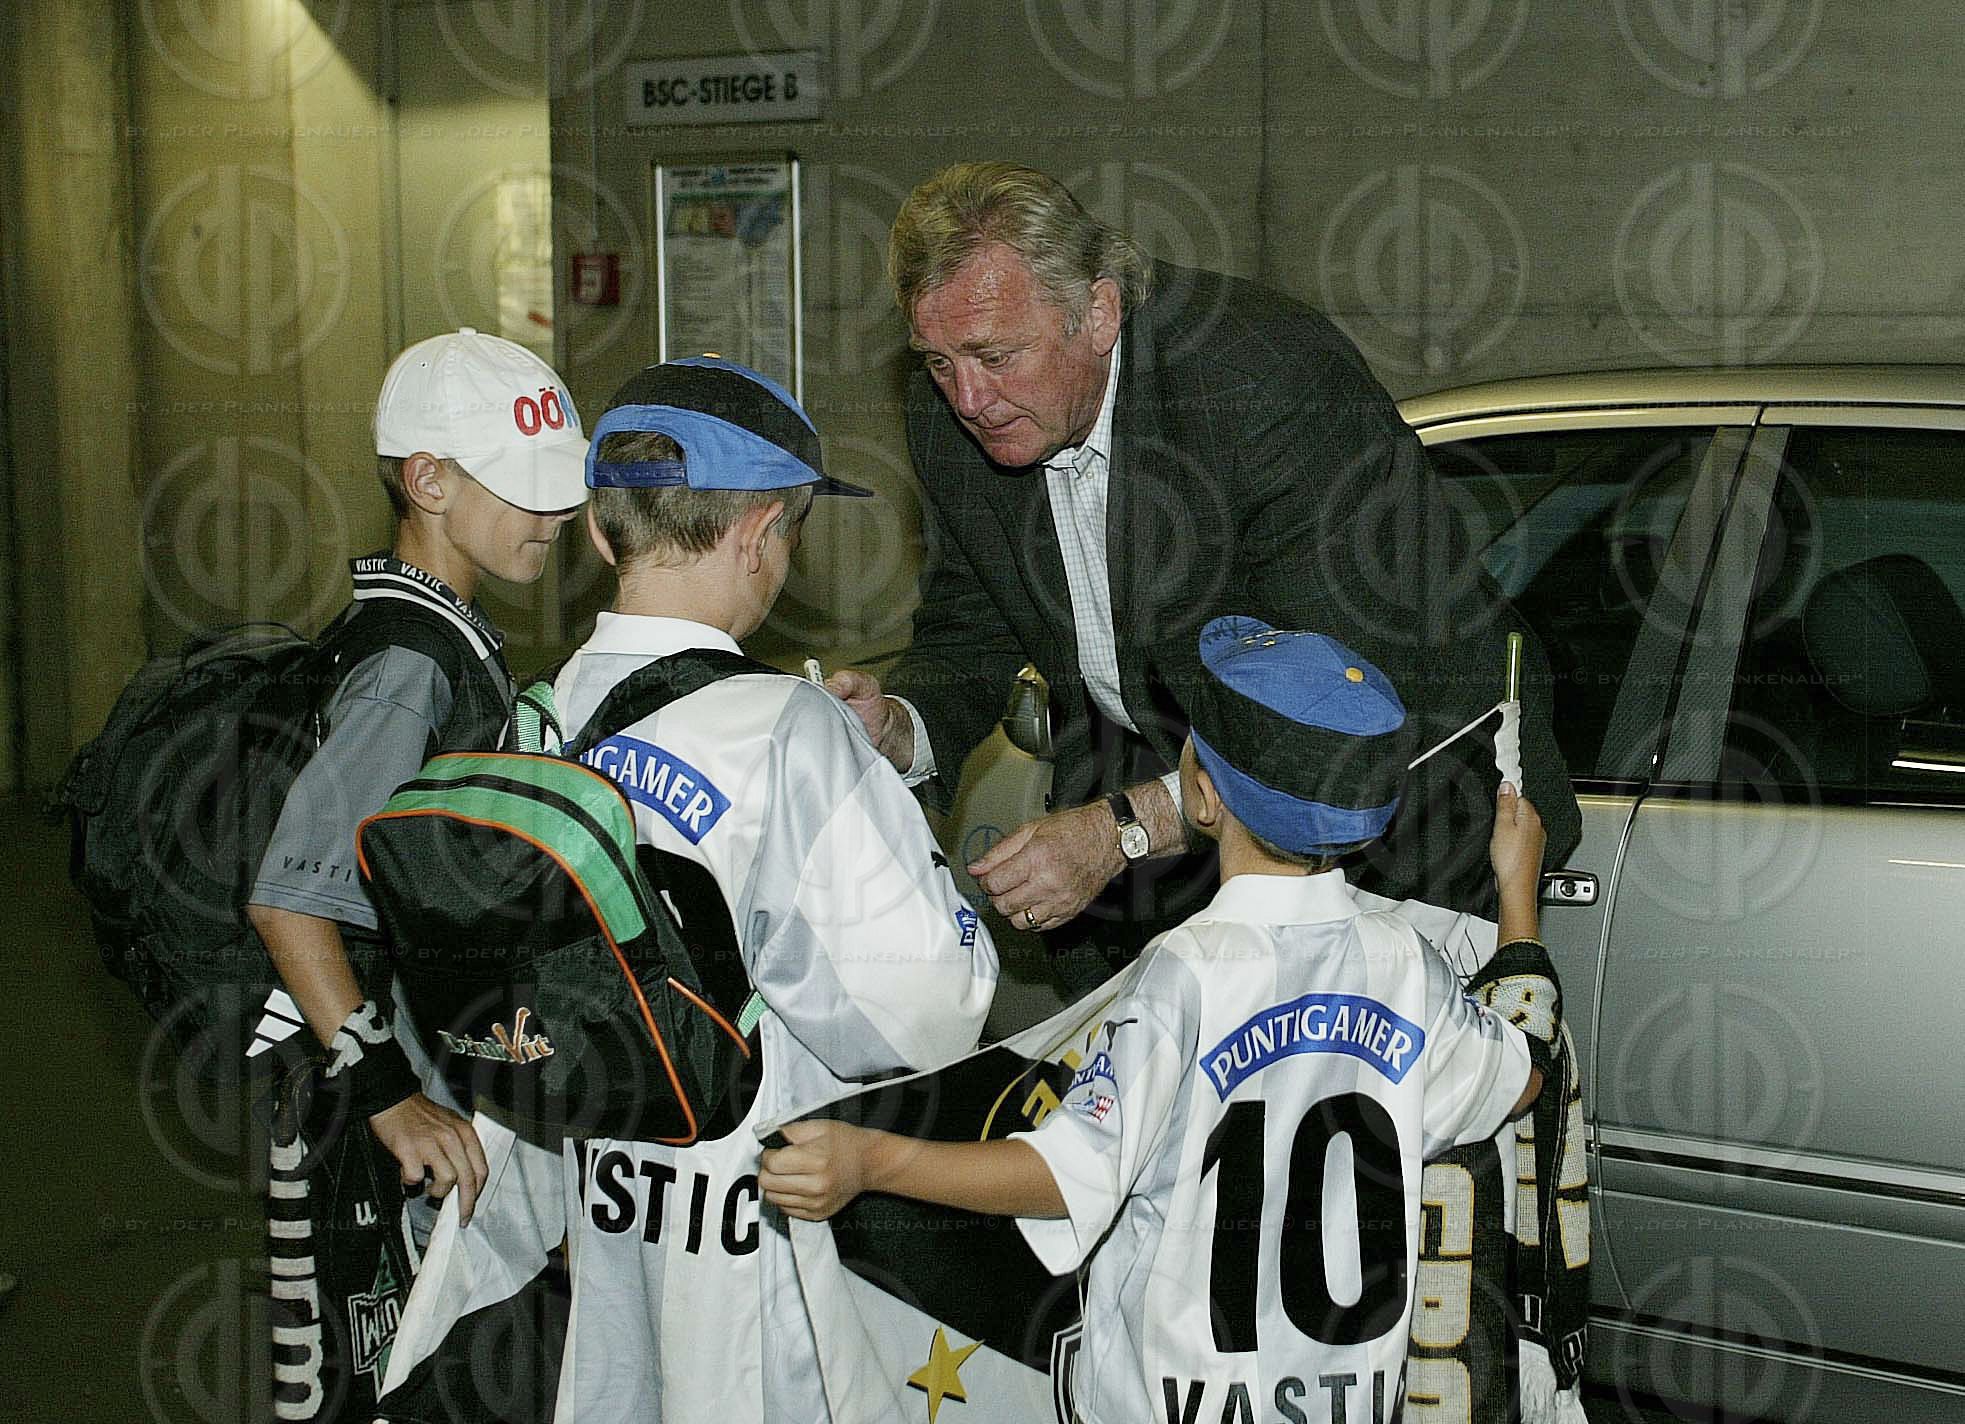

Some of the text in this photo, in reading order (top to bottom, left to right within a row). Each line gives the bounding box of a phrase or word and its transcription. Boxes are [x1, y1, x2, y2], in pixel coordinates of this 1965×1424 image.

[642, 72, 799, 108] BSC-STIEGE B
[356, 558, 387, 572] VASTIC
[401, 562, 446, 592] VASTIC
[283, 855, 353, 882] VASTI
[1210, 1004, 1413, 1091] PUNTIGAMER
[1199, 1091, 1408, 1353] 10
[1162, 1370, 1408, 1424] VASTI
